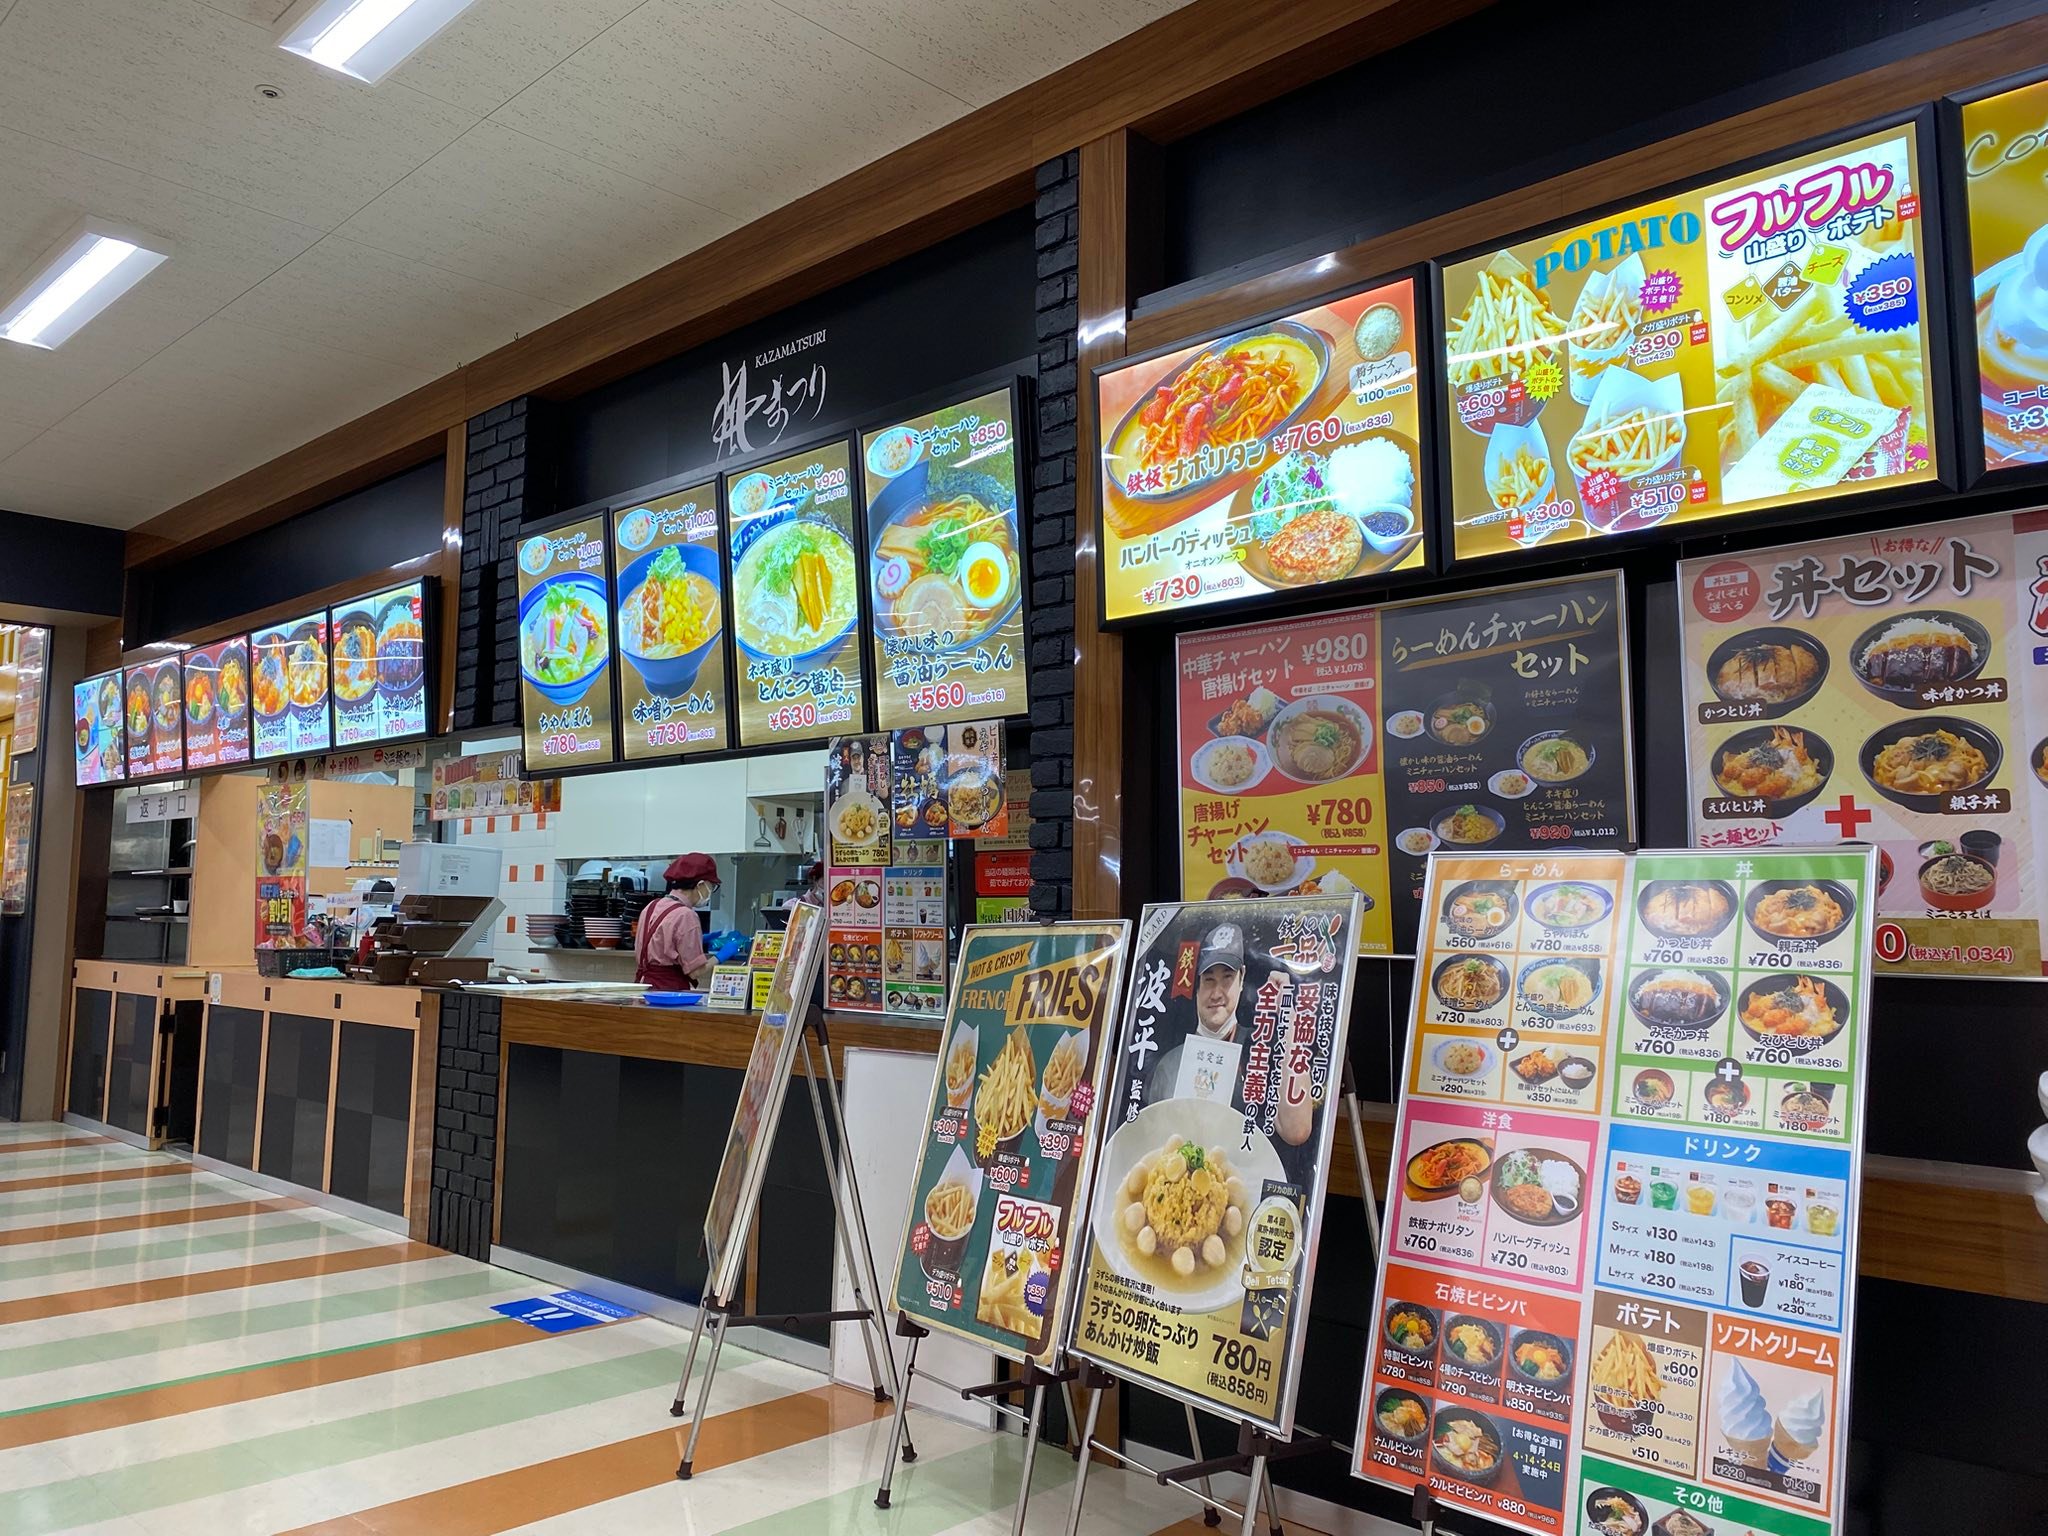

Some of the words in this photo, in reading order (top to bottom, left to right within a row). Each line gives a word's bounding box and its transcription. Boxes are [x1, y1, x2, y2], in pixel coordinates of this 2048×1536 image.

[1711, 162, 1895, 252] フルフル
[1534, 211, 1701, 290] POTATO
[1808, 255, 1845, 274] チーズ
[1725, 295, 1763, 305] コンソメ
[1772, 286, 1801, 298] バター
[755, 329, 828, 368] KAZAMATSURI
[912, 415, 980, 445] ミニチャーハン
[969, 420, 1007, 445] ¥850
[931, 439, 960, 456] セット
[768, 463, 824, 489] ミニチャーハン
[1126, 466, 1164, 497] 鉄板
[1169, 440, 1266, 487] ナポリタン
[815, 468, 846, 491] ¥920
[1587, 478, 1617, 495] ポテトの
[1636, 470, 1688, 488] デカ盛りポテト
[783, 484, 808, 499] セット
[663, 521, 684, 535] セット
[685, 509, 716, 531] ¥1,020
[1120, 524, 1252, 569] ハンバーグディッシュ
[1883, 539, 1929, 553] お得な
[1184, 551, 1241, 570] オニオンソース
[1766, 538, 1999, 621] 丼セット
[1703, 587, 1751, 602] それぞれ
[1708, 600, 1744, 614] 選べる
[1391, 594, 1609, 665] らーめんチャーハン
[884, 630, 954, 657] 懐かし味の
[892, 644, 1013, 688] 醤油らーめん
[1182, 636, 1291, 680] 中華チャーハン
[1510, 643, 1590, 679] セット
[747, 657, 793, 681] ネギ盛り
[758, 666, 845, 702] とんこつ醤油
[1201, 658, 1295, 701] 唐揚げセット
[817, 692, 856, 708] らーめん
[908, 682, 966, 712] ¥560
[1922, 685, 2003, 703] 味噌かつ丼
[632, 690, 714, 725] 味噌らーめん
[769, 703, 816, 730] ¥630
[1704, 703, 1763, 719] かつとじ丼
[385, 720, 405, 734] ¥760
[539, 706, 593, 734] ちゃんぽん
[339, 727, 359, 743] ¥760
[647, 721, 688, 747] ¥730
[544, 733, 577, 755] ¥780
[1406, 763, 1478, 776] ミニチャーハンセット
[1408, 778, 1445, 794] ¥850
[140, 795, 186, 818] 返却口
[1193, 798, 1241, 823] 唐揚げ
[1707, 800, 1767, 815] えびとじ丼
[1949, 794, 2001, 811] 親子丼
[1524, 810, 1605, 822] ミニチャーハンセット
[1187, 816, 1270, 847] チャーハン
[1529, 824, 1572, 840] ¥920
[1207, 841, 1249, 865] セット
[1500, 863, 1565, 877] らーめん
[1735, 860, 1754, 878] 丼
[269, 898, 291, 923] 割引
[890, 930, 907, 938] ポテト
[915, 930, 943, 938] ソフトクリーム
[1278, 914, 1318, 939] 鉄人の
[1446, 936, 1476, 948] ¥560
[1530, 939, 1562, 950] ¥780
[1656, 937, 1713, 950] かつとじ丼
[1777, 940, 1818, 953] 親子丼
[1643, 949, 1682, 963] ¥760
[1748, 952, 1792, 967] ¥760
[1908, 944, 2014, 963] (税込¥1,034)
[971, 963, 986, 979] HOT
[987, 961, 993, 973] &
[995, 949, 1026, 970] CRISPY
[1178, 946, 1195, 989] 鉄人
[961, 989, 1015, 1011] FRENCH
[1015, 964, 1099, 1021] FRIES
[1516, 993, 1544, 1001] ネギ盛り
[1128, 959, 1171, 1071] 波平
[1436, 1011, 1465, 1023] ¥730
[1521, 1017, 1554, 1029] ¥630
[1310, 984, 1338, 1099] 味も技も、一切の
[1649, 1025, 1710, 1042] みそかつ丼
[1759, 1033, 1824, 1049] えびとじ丼
[1286, 984, 1320, 1105] 妥協なし
[1634, 1039, 1675, 1055] ¥760
[1264, 985, 1294, 1136] 一皿にすべてを込める
[1746, 1047, 1790, 1064] ¥760
[1240, 982, 1280, 1152] 全力主義の鉄人
[1431, 1075, 1487, 1086] ミニチャーハンセット
[1440, 1084, 1463, 1094] ¥290
[1125, 1078, 1143, 1124] 監修
[1527, 1093, 1551, 1103] ¥350
[1630, 1106, 1654, 1116] ¥180
[1704, 1113, 1730, 1124] ¥180
[934, 1119, 957, 1135] ¥300
[1482, 1111, 1513, 1130] 洋食
[1779, 1121, 1808, 1132] ¥180
[1040, 1134, 1069, 1151] ¥390
[1684, 1136, 1762, 1162] ドリンク
[990, 1167, 1018, 1184] ¥600
[1266, 1183, 1298, 1198] デリカの鉄人
[998, 1201, 1055, 1239] フルフル
[1267, 1214, 1286, 1227] 第4回
[1408, 1216, 1475, 1238] 鉄板ナポリタン
[1611, 1221, 1639, 1235] Sサイズ
[1646, 1226, 1678, 1242] ¥130
[1003, 1230, 1023, 1246] 山盛り
[1028, 1238, 1050, 1253] ポテト
[1258, 1237, 1287, 1262] 認定
[1404, 1233, 1437, 1251] ¥760
[1491, 1250, 1528, 1268] ¥730
[1609, 1243, 1640, 1258] Mサイズ
[1644, 1249, 1676, 1266] ¥180
[1776, 1252, 1836, 1269] アイスコーヒー
[1245, 1275, 1260, 1286] Deli
[1266, 1275, 1289, 1285] Tetsu
[1607, 1266, 1635, 1281] Lサイズ
[1641, 1272, 1676, 1289] ¥230
[1778, 1278, 1805, 1291] ¥180
[1793, 1273, 1816, 1284] Sサイズ
[926, 1281, 953, 1299] ¥510
[1027, 1284, 1047, 1297] ¥350
[1435, 1281, 1528, 1316] 石焼ビビンバ
[1776, 1303, 1805, 1316] ¥230
[1792, 1296, 1817, 1308] Mサイズ
[1090, 1296, 1199, 1350] うずらの卵たっぷり
[1616, 1302, 1681, 1335] ポテト
[1085, 1320, 1161, 1365] あんかけ炒飯
[1716, 1322, 1835, 1369] ソフトクリーム
[1211, 1334, 1272, 1382] 780円
[1382, 1365, 1406, 1380] ¥780
[1663, 1362, 1699, 1379] ¥600
[1441, 1381, 1467, 1396] ¥790
[1506, 1380, 1572, 1406] 明太子ビビンバ
[1593, 1384, 1633, 1399] 山盛りポテト
[1506, 1397, 1534, 1413] ¥850
[1635, 1399, 1665, 1415] ¥300
[1588, 1425, 1636, 1443] デカ盛りポテト
[1633, 1424, 1663, 1439] ¥390
[1373, 1435, 1424, 1460] ナムルビビンバ
[1529, 1444, 1546, 1457] 毎月
[1631, 1447, 1659, 1462] ¥510
[1373, 1451, 1397, 1467] ¥730
[1521, 1464, 1548, 1480] 実施中
[1496, 1499, 1526, 1516] ¥880
[1673, 1486, 1725, 1514] その他
